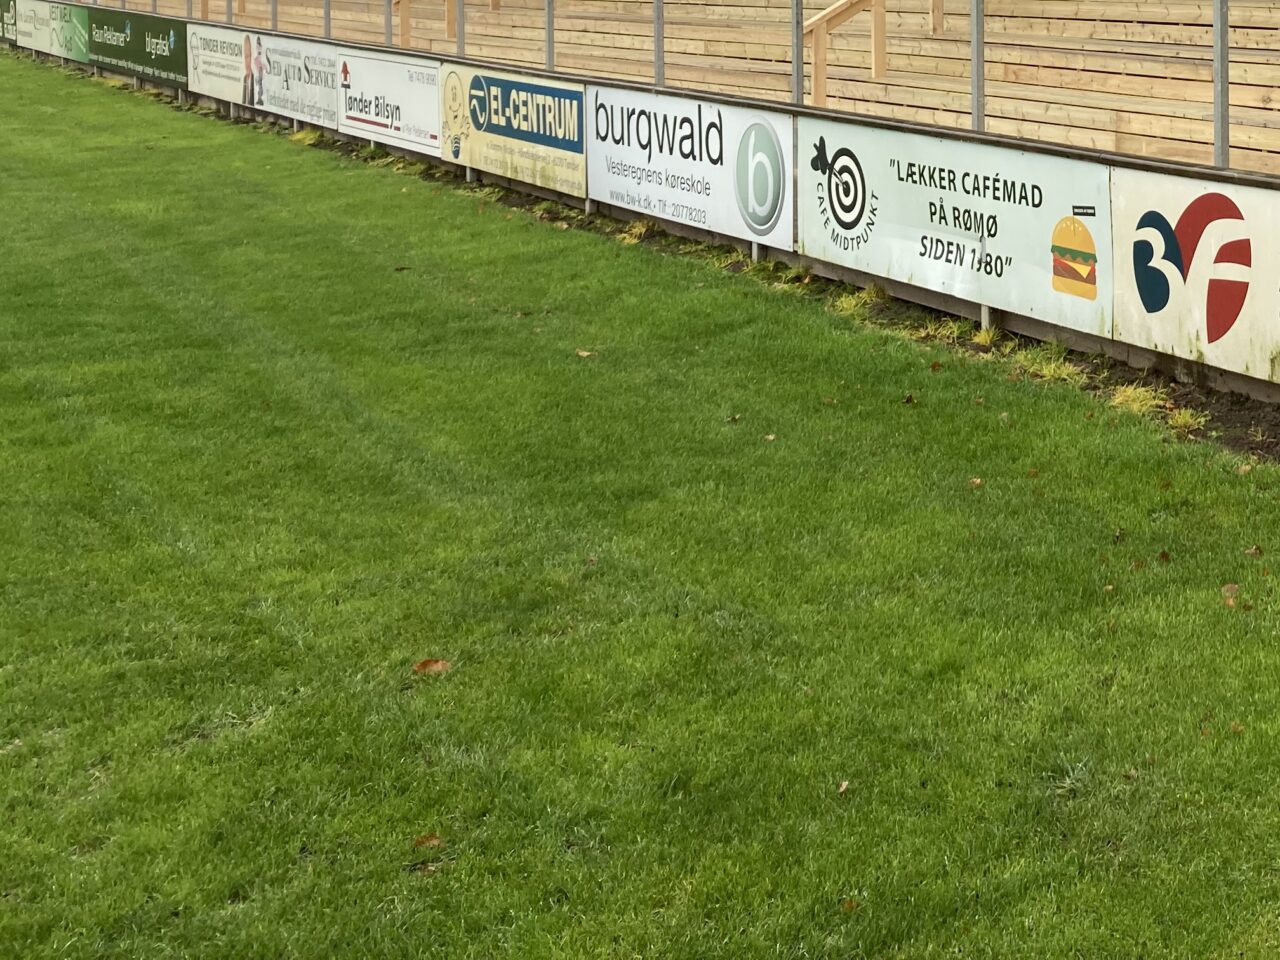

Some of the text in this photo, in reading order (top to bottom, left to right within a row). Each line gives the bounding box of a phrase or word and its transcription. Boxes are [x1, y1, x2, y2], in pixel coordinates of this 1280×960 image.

[219, 40, 243, 57] REVISION
[304, 56, 337, 90] SERVICE
[344, 86, 401, 129] Tønder Bilsyn
[489, 85, 578, 142] EL-CENTRUM
[595, 90, 724, 166] burgwald
[605, 155, 663, 185] Vesteregnens
[665, 168, 711, 197] køreskole
[961, 172, 1043, 209] CAFÉMAD
[671, 202, 707, 225] 20778203
[817, 182, 879, 252] CAFE MIDTPUNKT
[929, 196, 998, 239] PÅ RØMØ
[919, 235, 966, 267] SIDEN
